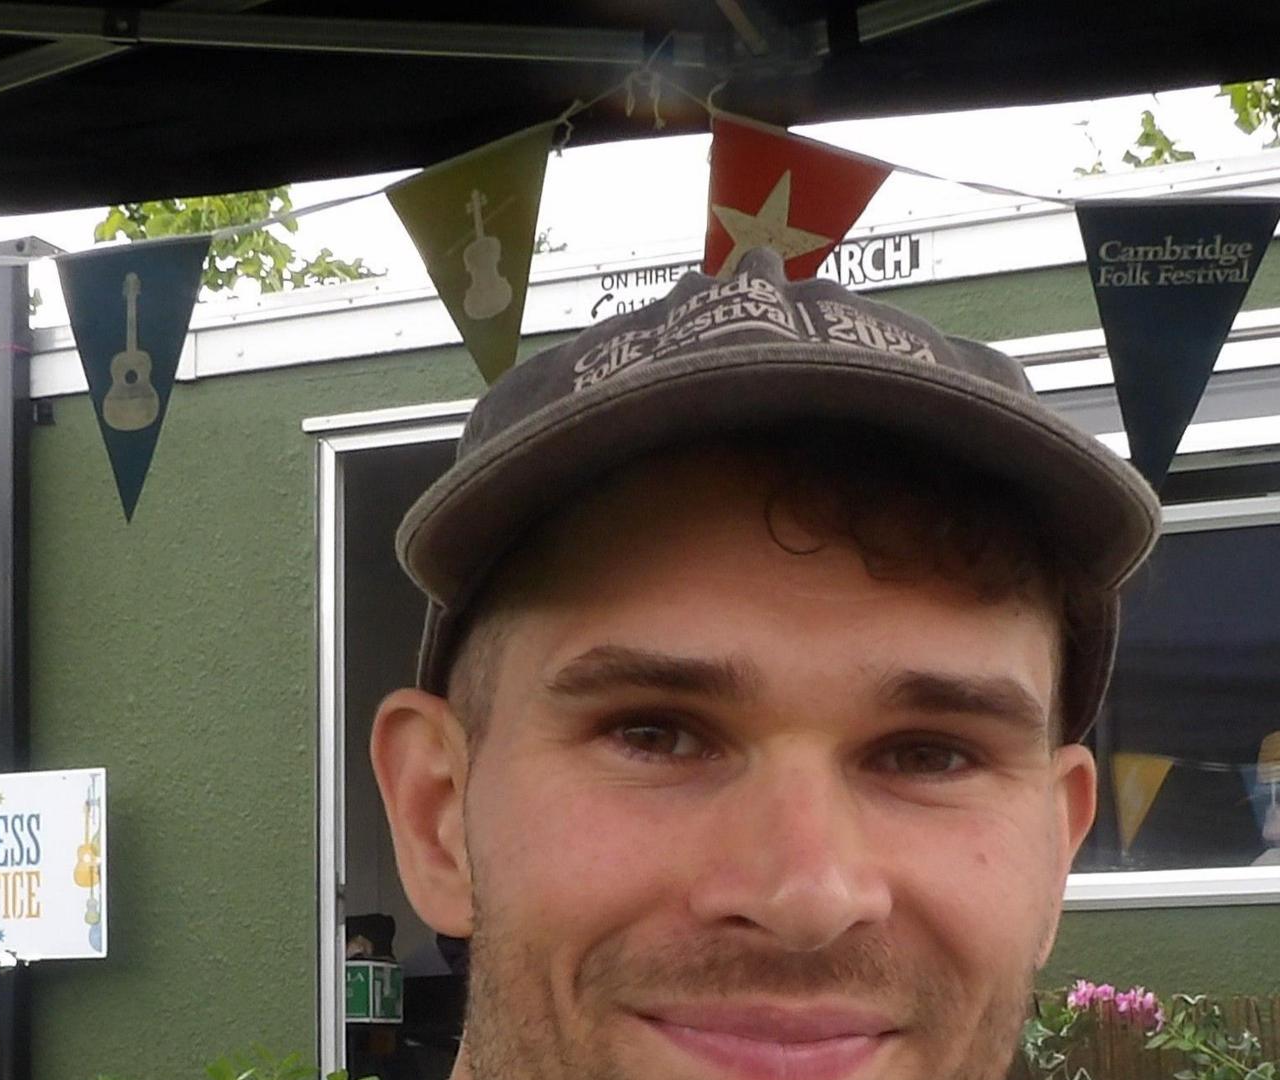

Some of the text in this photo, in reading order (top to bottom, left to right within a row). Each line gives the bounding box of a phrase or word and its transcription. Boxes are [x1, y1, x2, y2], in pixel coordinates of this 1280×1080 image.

[1098, 234, 1254, 266] Cambridge
[601, 272, 628, 291] ON
[635, 264, 680, 288] HIRE
[1096, 260, 1250, 287] Folk Festival
[573, 338, 644, 393] Folk
[655, 297, 800, 350] Festival
